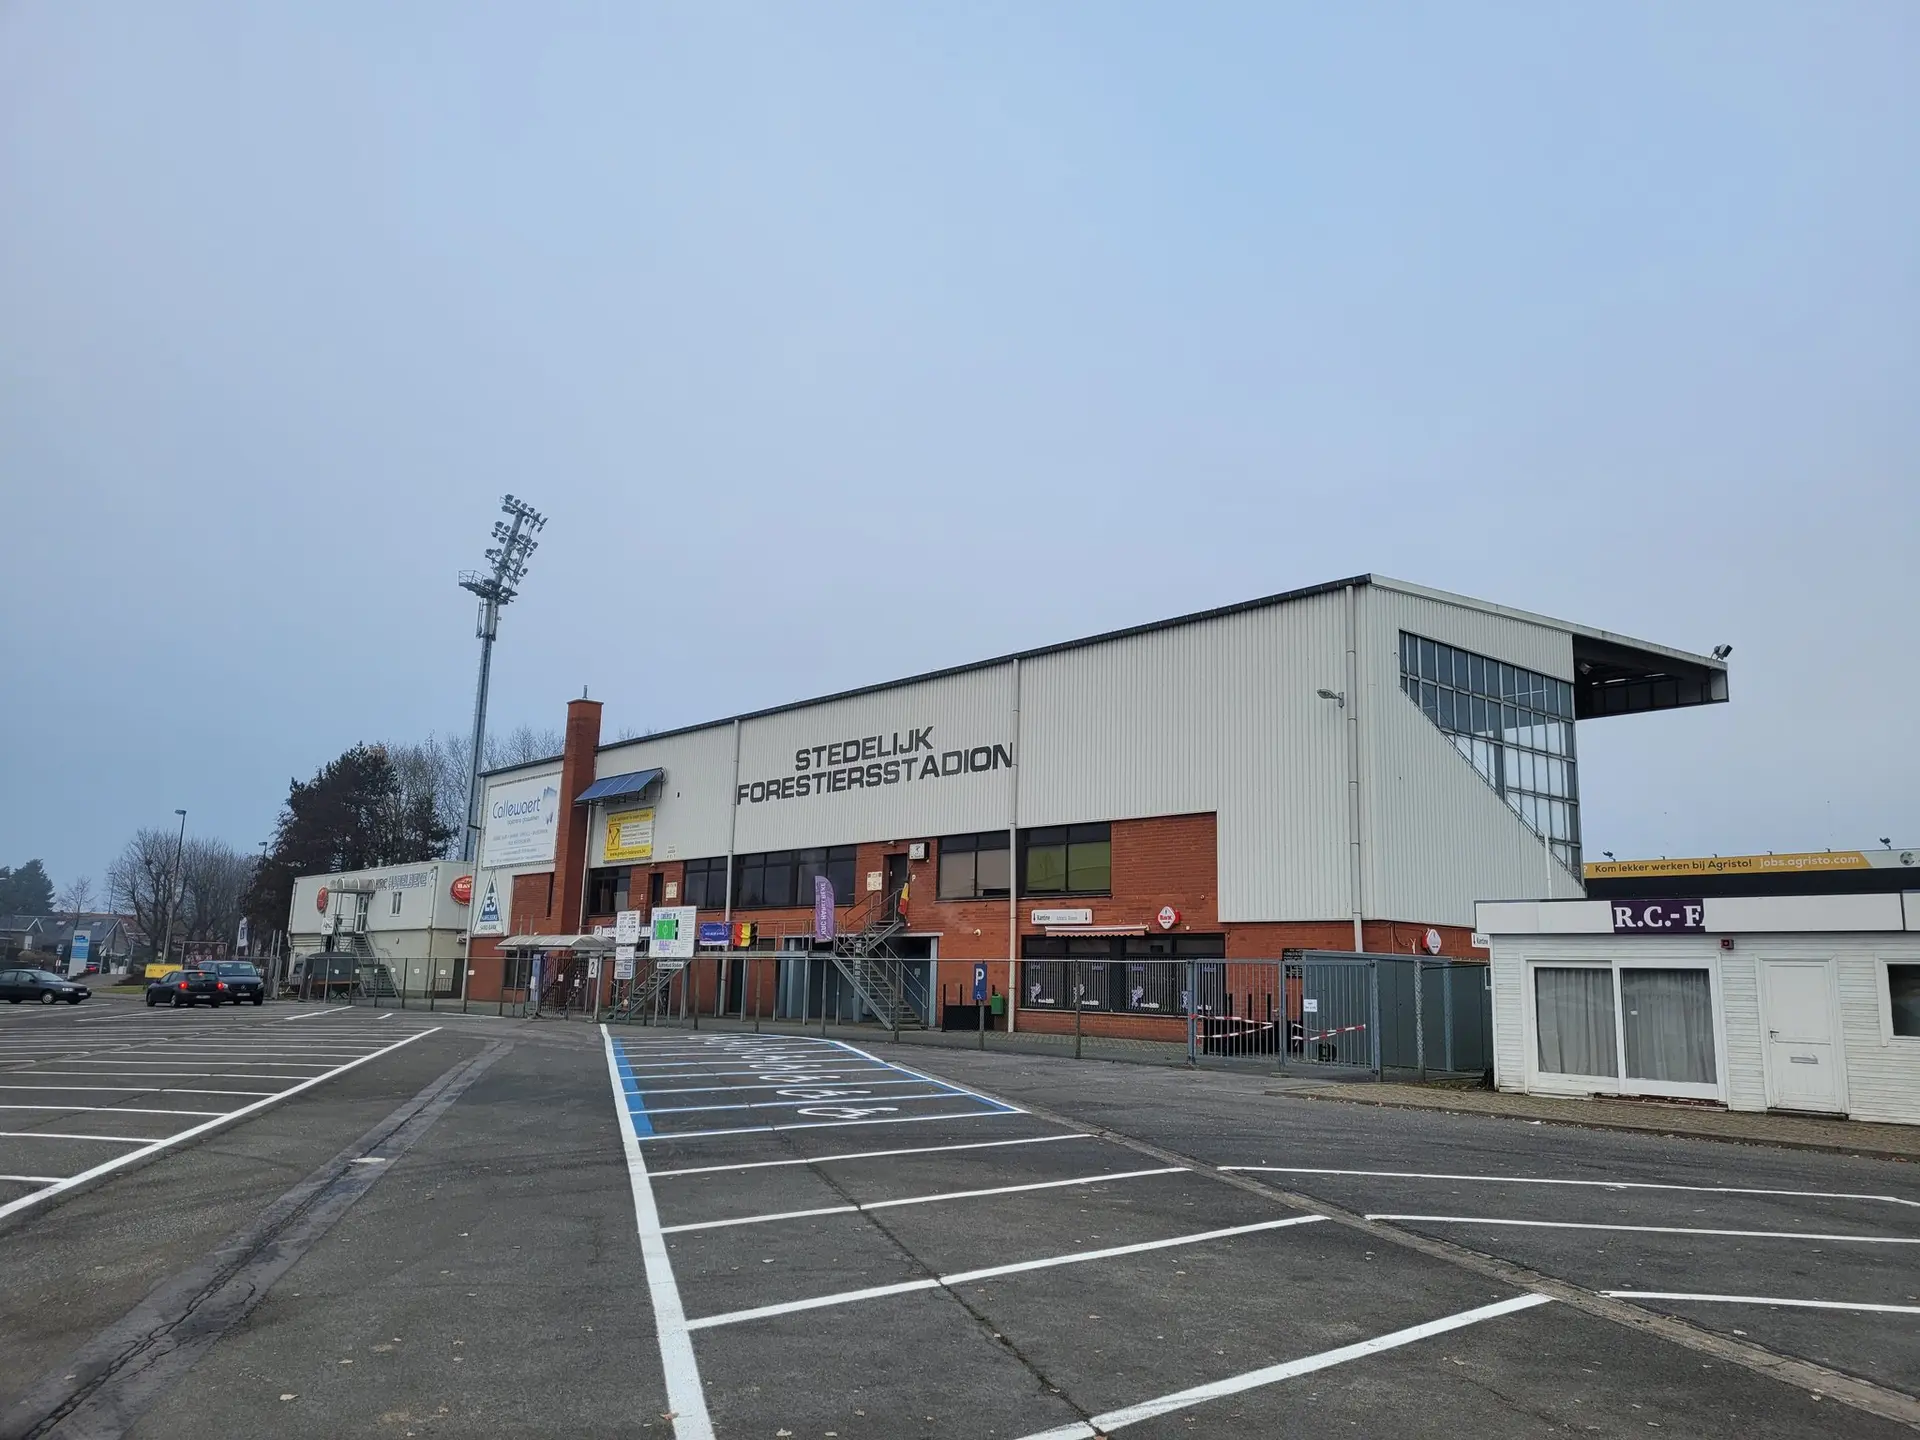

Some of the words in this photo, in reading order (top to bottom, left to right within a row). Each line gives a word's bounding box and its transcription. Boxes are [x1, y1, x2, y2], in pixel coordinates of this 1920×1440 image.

[795, 725, 934, 771] STEDELIJK
[736, 742, 1013, 805] FORESTIERSSTADION
[493, 797, 540, 818] Callewaert
[1595, 865, 1617, 873] Kom
[1619, 863, 1650, 872] lekker
[1652, 861, 1690, 870] werken
[1692, 860, 1705, 871] bij
[1707, 859, 1753, 871] Agristo!
[1759, 856, 1860, 869] jobs.agristo.com
[590, 961, 595, 975] 2
[976, 968, 984, 986] P
